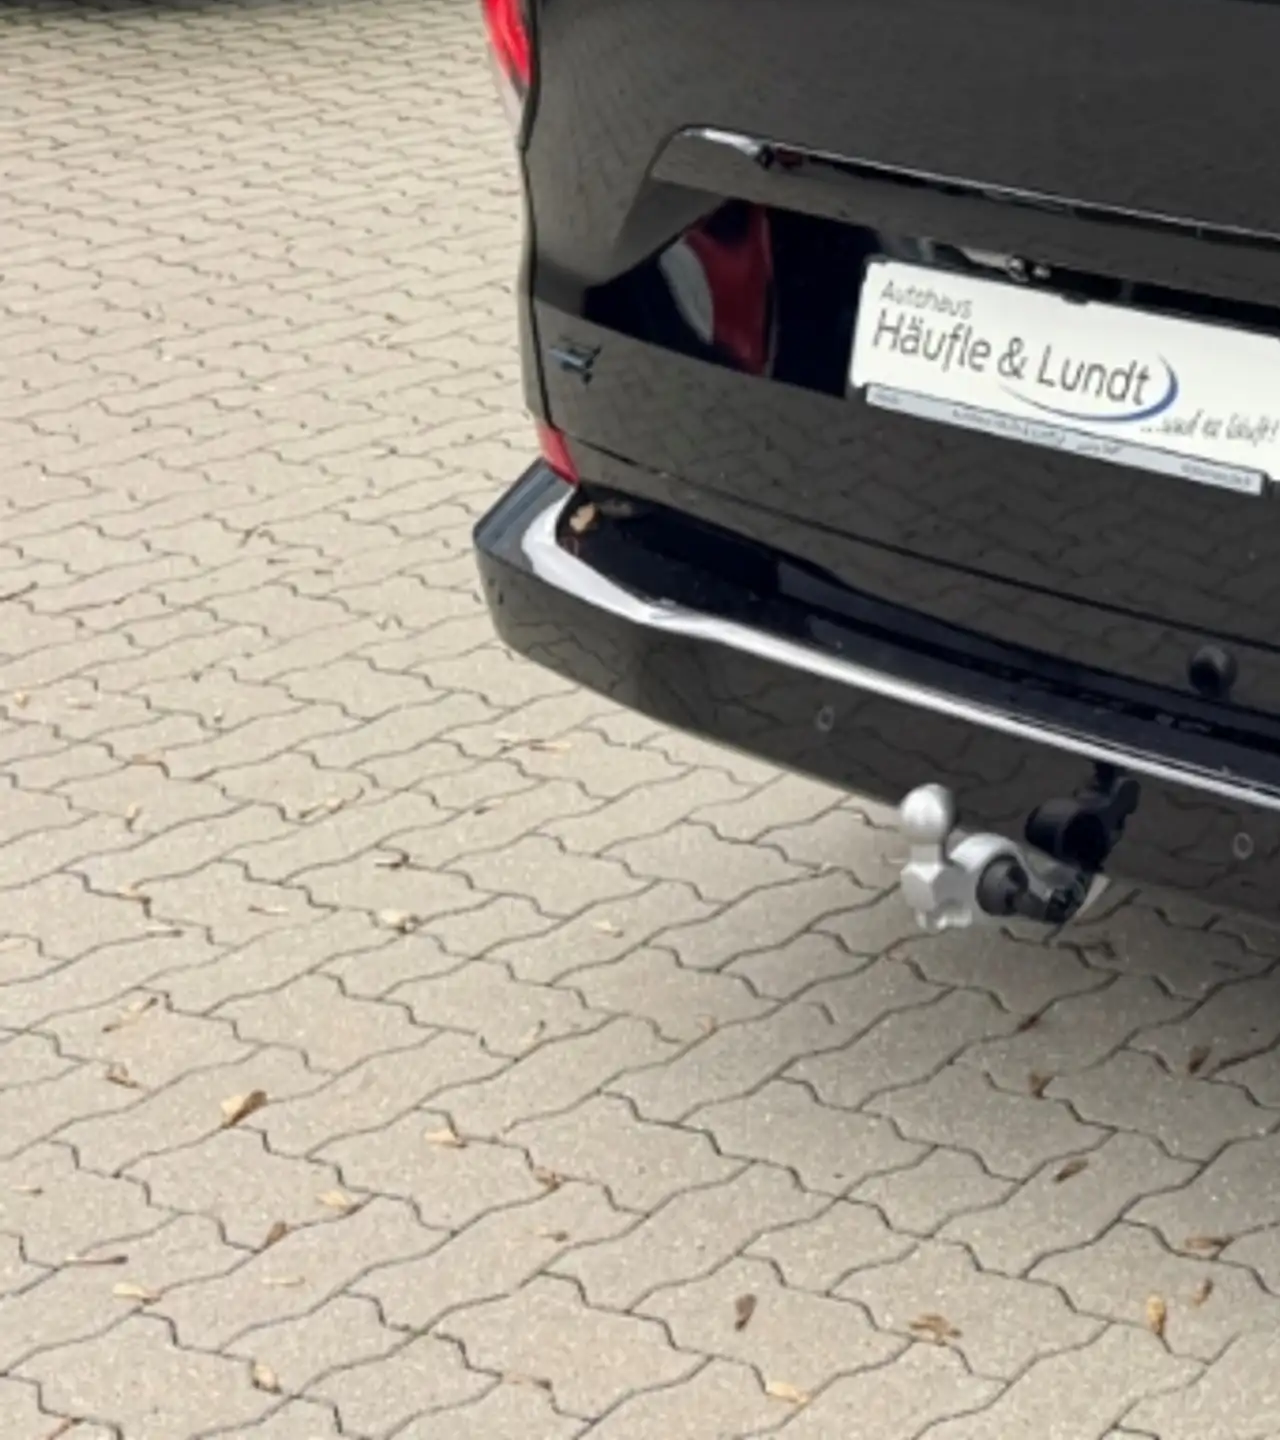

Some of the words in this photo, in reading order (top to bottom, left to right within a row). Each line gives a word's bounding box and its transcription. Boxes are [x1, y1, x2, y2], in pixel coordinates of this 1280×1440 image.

[880, 279, 973, 320] Autohaus
[871, 308, 992, 373] Häufle
[996, 336, 1029, 381] &
[1035, 343, 1151, 407] Lundt
